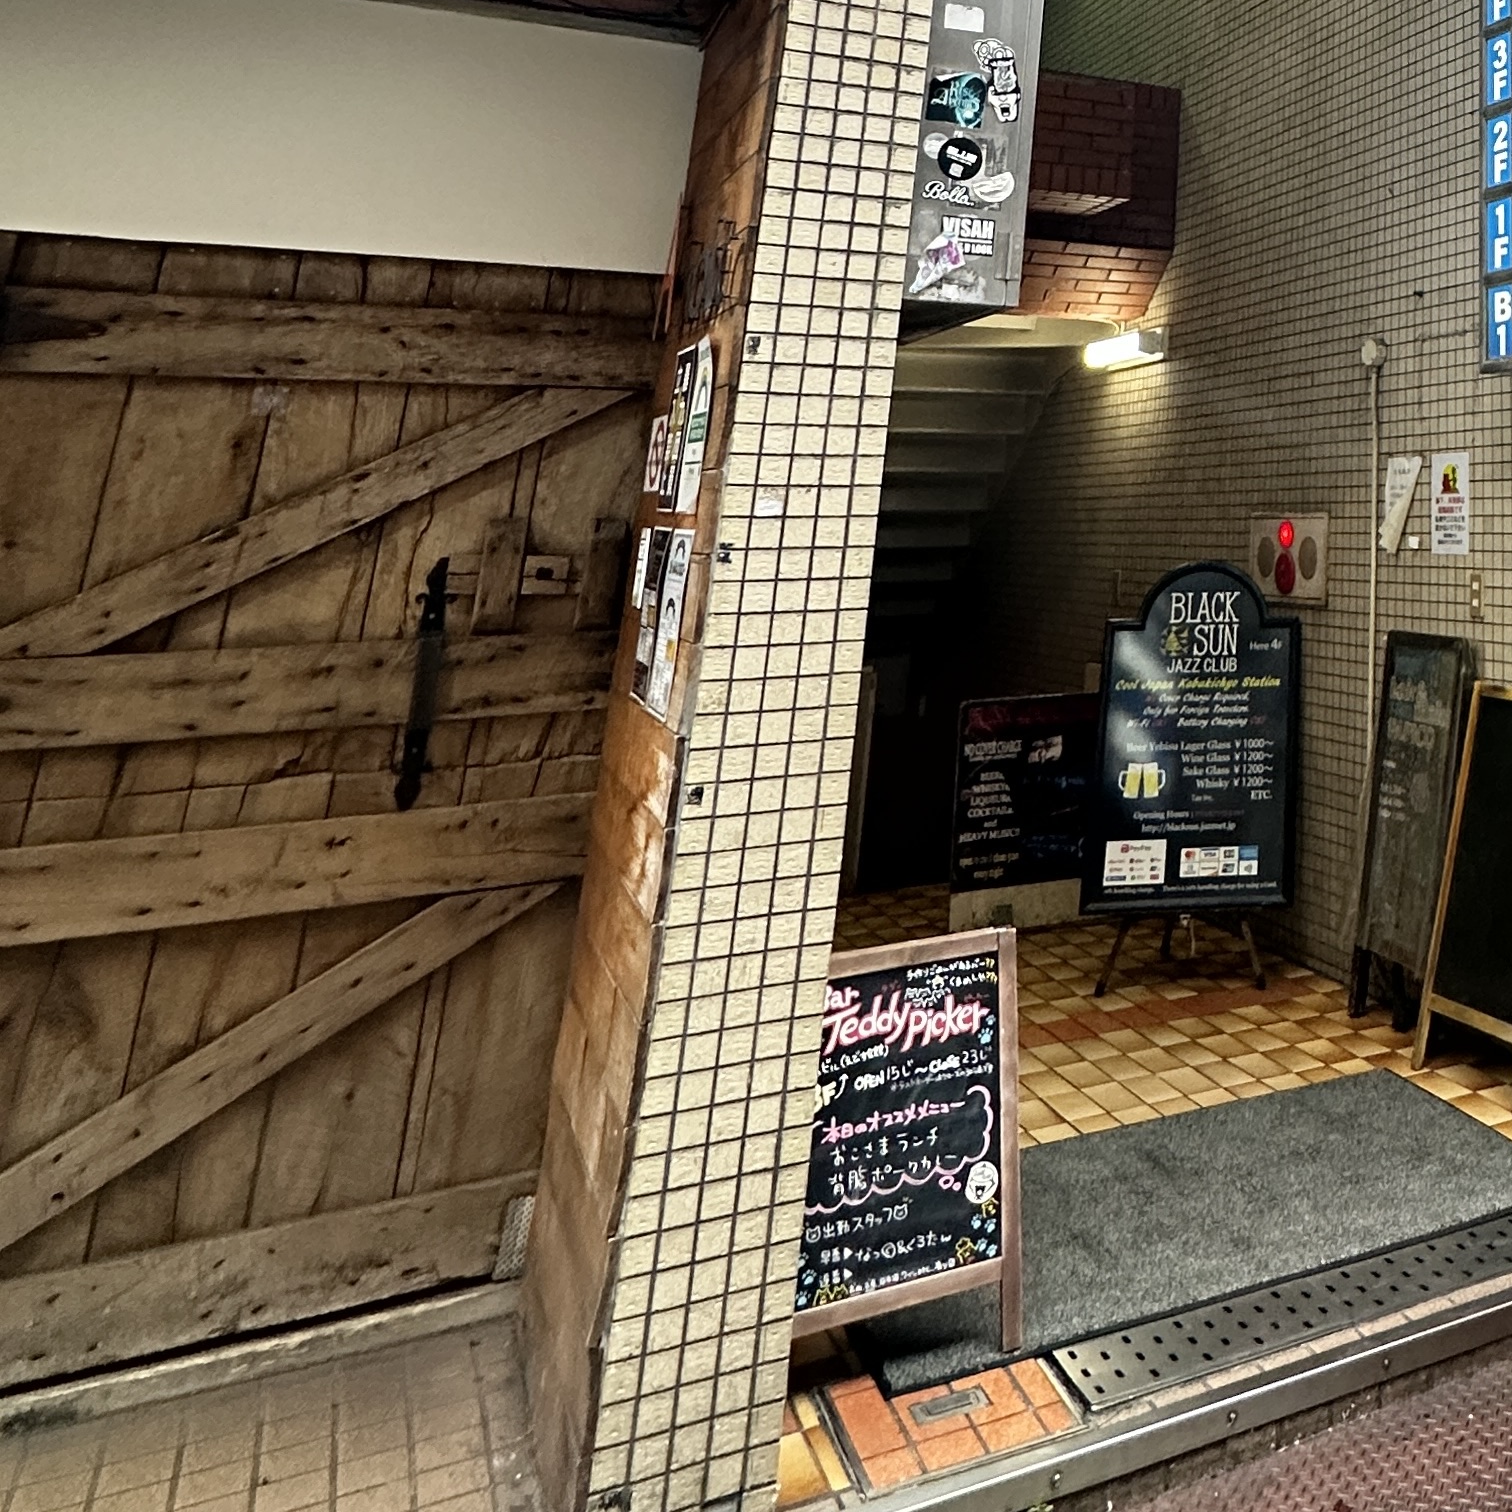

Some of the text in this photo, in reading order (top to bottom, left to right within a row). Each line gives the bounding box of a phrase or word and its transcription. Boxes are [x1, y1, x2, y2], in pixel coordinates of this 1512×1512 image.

[1493, 39, 1508, 101] 3F
[1493, 120, 1508, 184] 2F
[1494, 202, 1509, 269] 1F
[1493, 290, 1512, 356] B1
[1169, 591, 1241, 624] BLACK
[1193, 624, 1239, 656] SUN
[1167, 657, 1237, 674] JAZZ CLUB
[1115, 679, 1139, 691] Cool
[1141, 678, 1173, 691] Japan
[1242, 676, 1281, 688] Station
[1177, 718, 1210, 727] Battery
[1211, 717, 1248, 727] Charging
[1181, 741, 1206, 752] Lager
[1207, 740, 1231, 750] Glass
[1182, 752, 1231, 764] Wine Glass
[1183, 764, 1230, 776] Sake Glass
[1196, 778, 1229, 789] Whisky
[1250, 791, 1273, 800] ETC.
[1133, 811, 1165, 820] Opening
[1166, 811, 1189, 819] Hours
[820, 1099, 966, 1145] 本日のオススメメニュー
[830, 1126, 940, 1167] おこさまランチ
[823, 1209, 892, 1234] 出勤スタッフ
